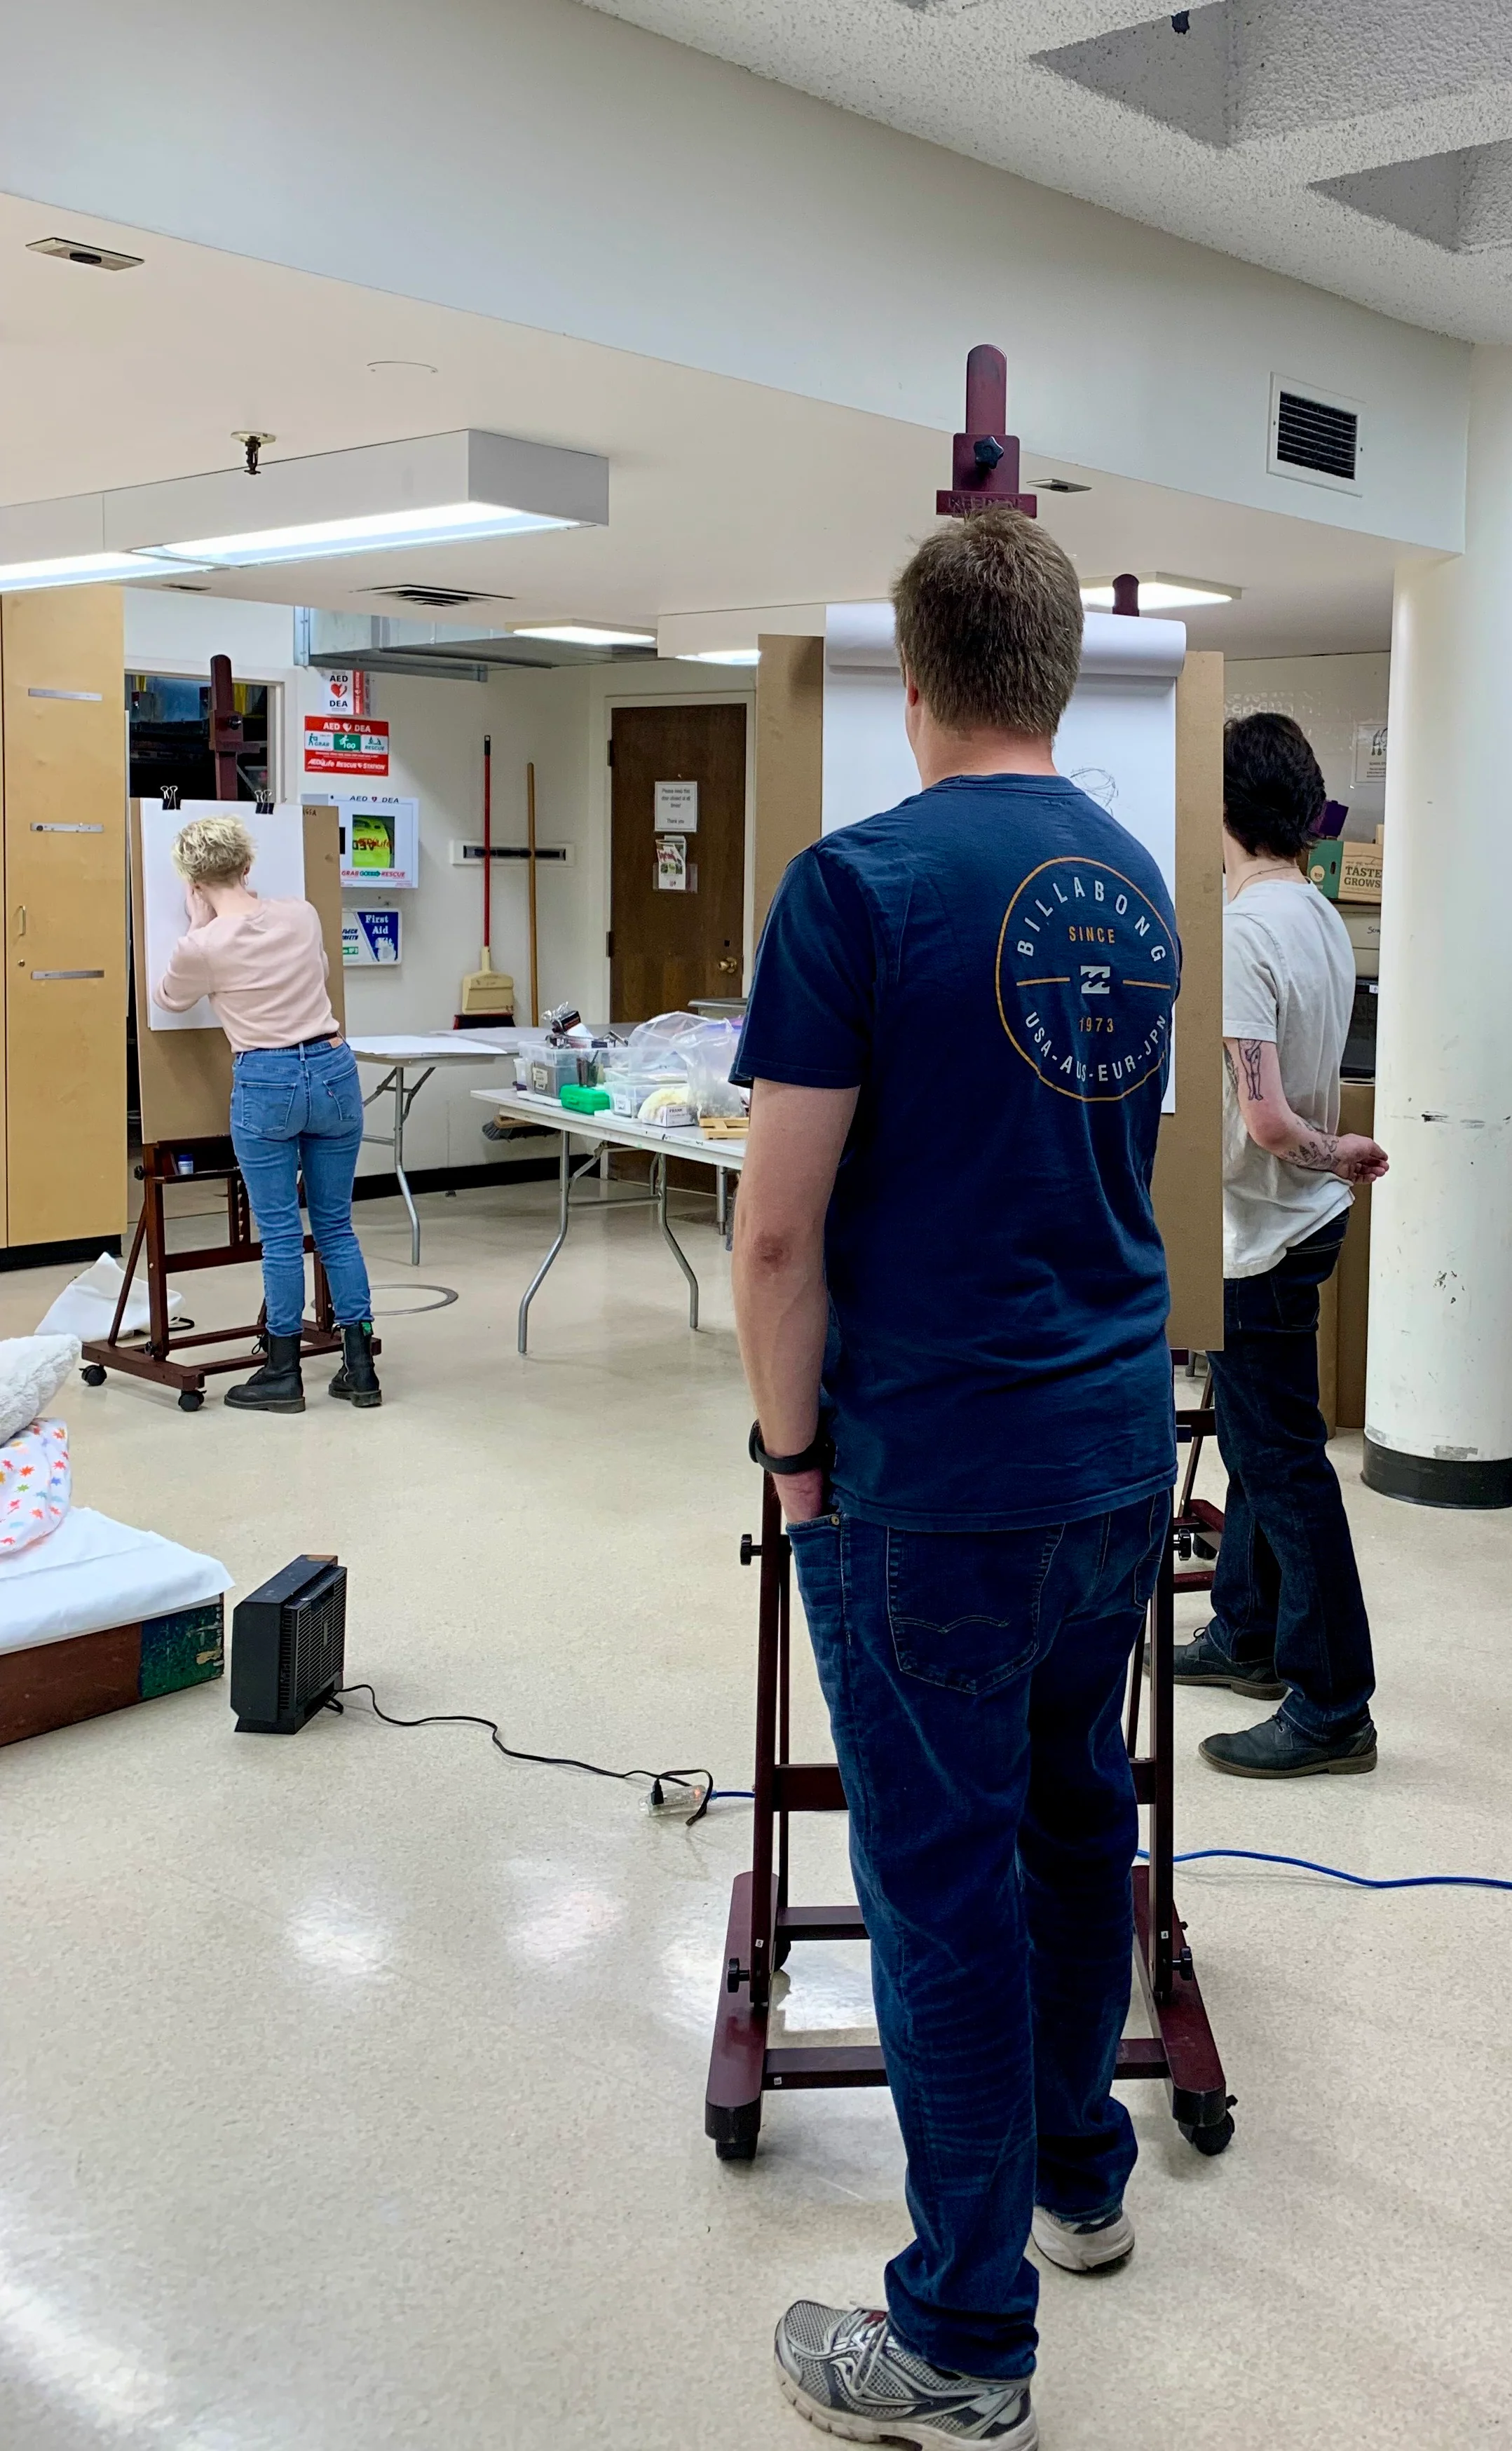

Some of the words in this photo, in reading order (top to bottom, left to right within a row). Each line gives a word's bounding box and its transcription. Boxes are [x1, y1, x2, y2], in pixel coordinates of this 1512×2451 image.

[354, 724, 372, 733] DEA
[1345, 866, 1382, 878] TASTE
[1344, 877, 1381, 888] GROWS
[365, 914, 389, 923] First
[1016, 876, 1166, 962] BILLABONG
[372, 925, 389, 935] Aid
[1068, 925, 1115, 944] SINCE
[1079, 1017, 1114, 1033] 1973
